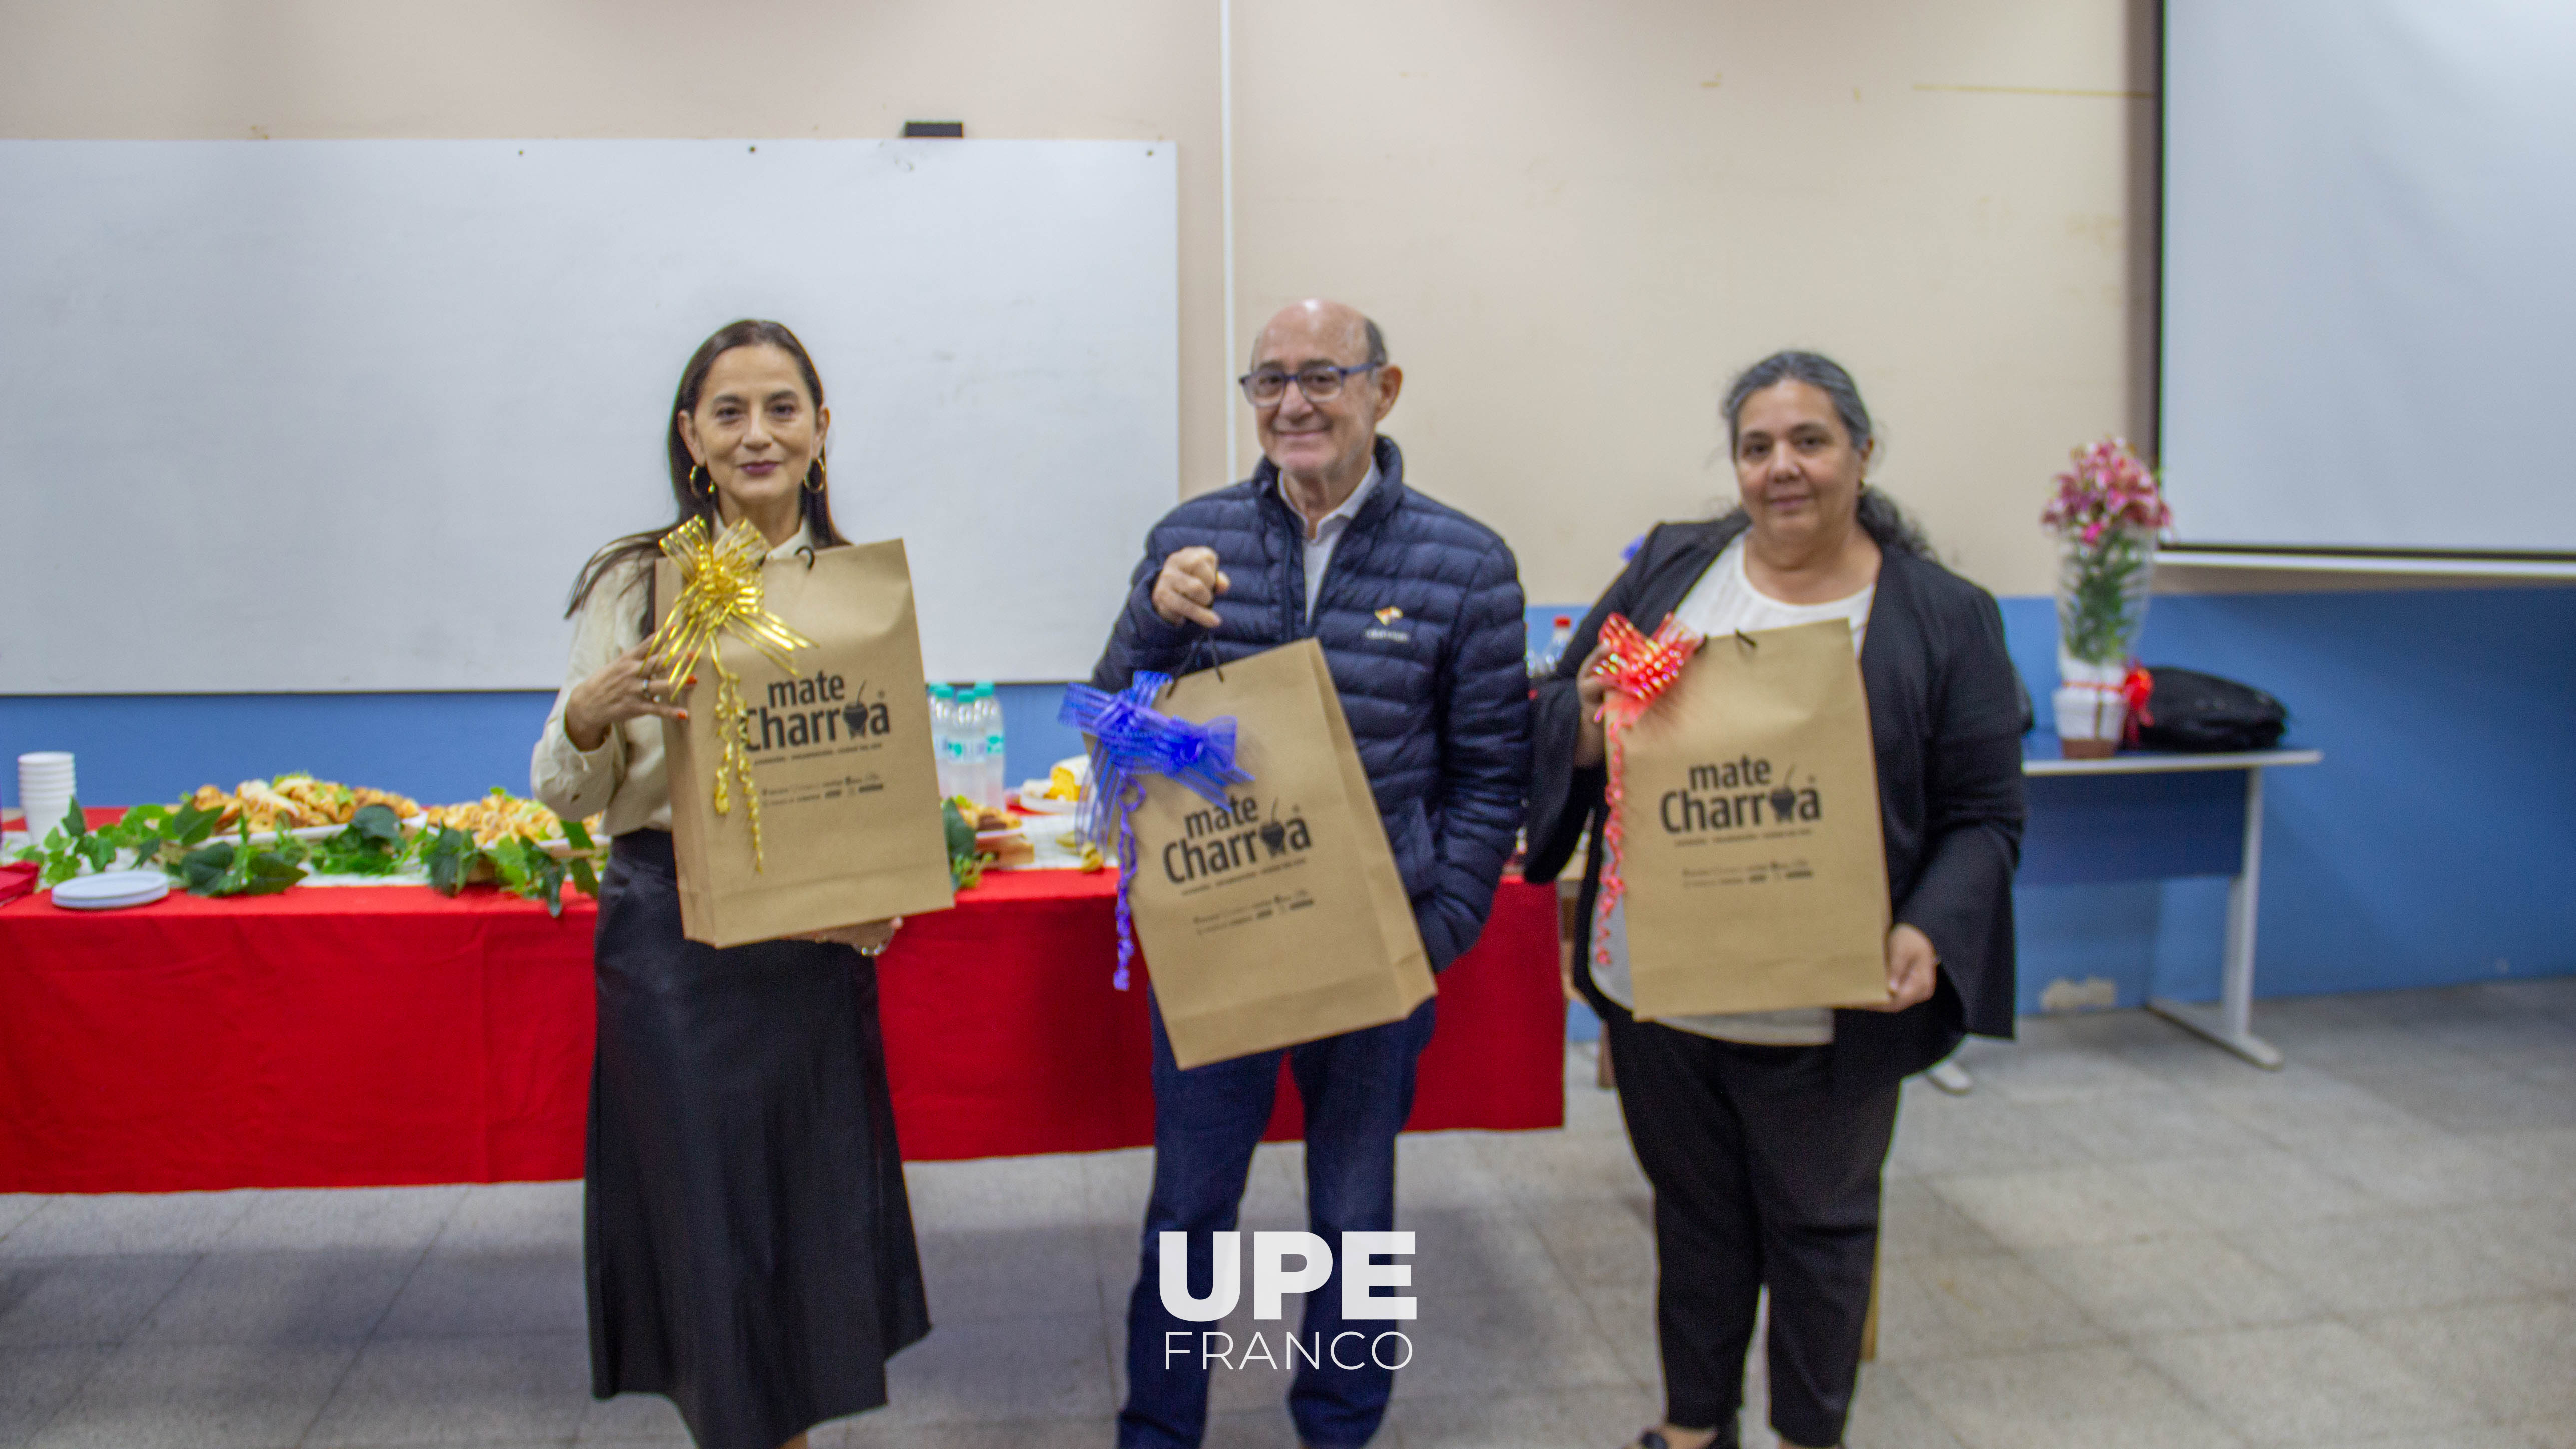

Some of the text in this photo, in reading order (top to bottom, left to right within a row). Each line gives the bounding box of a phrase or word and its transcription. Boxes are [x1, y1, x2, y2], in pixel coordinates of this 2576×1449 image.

[767, 670, 845, 709] mate
[1688, 754, 1771, 792] mate
[1184, 794, 1259, 839] mate
